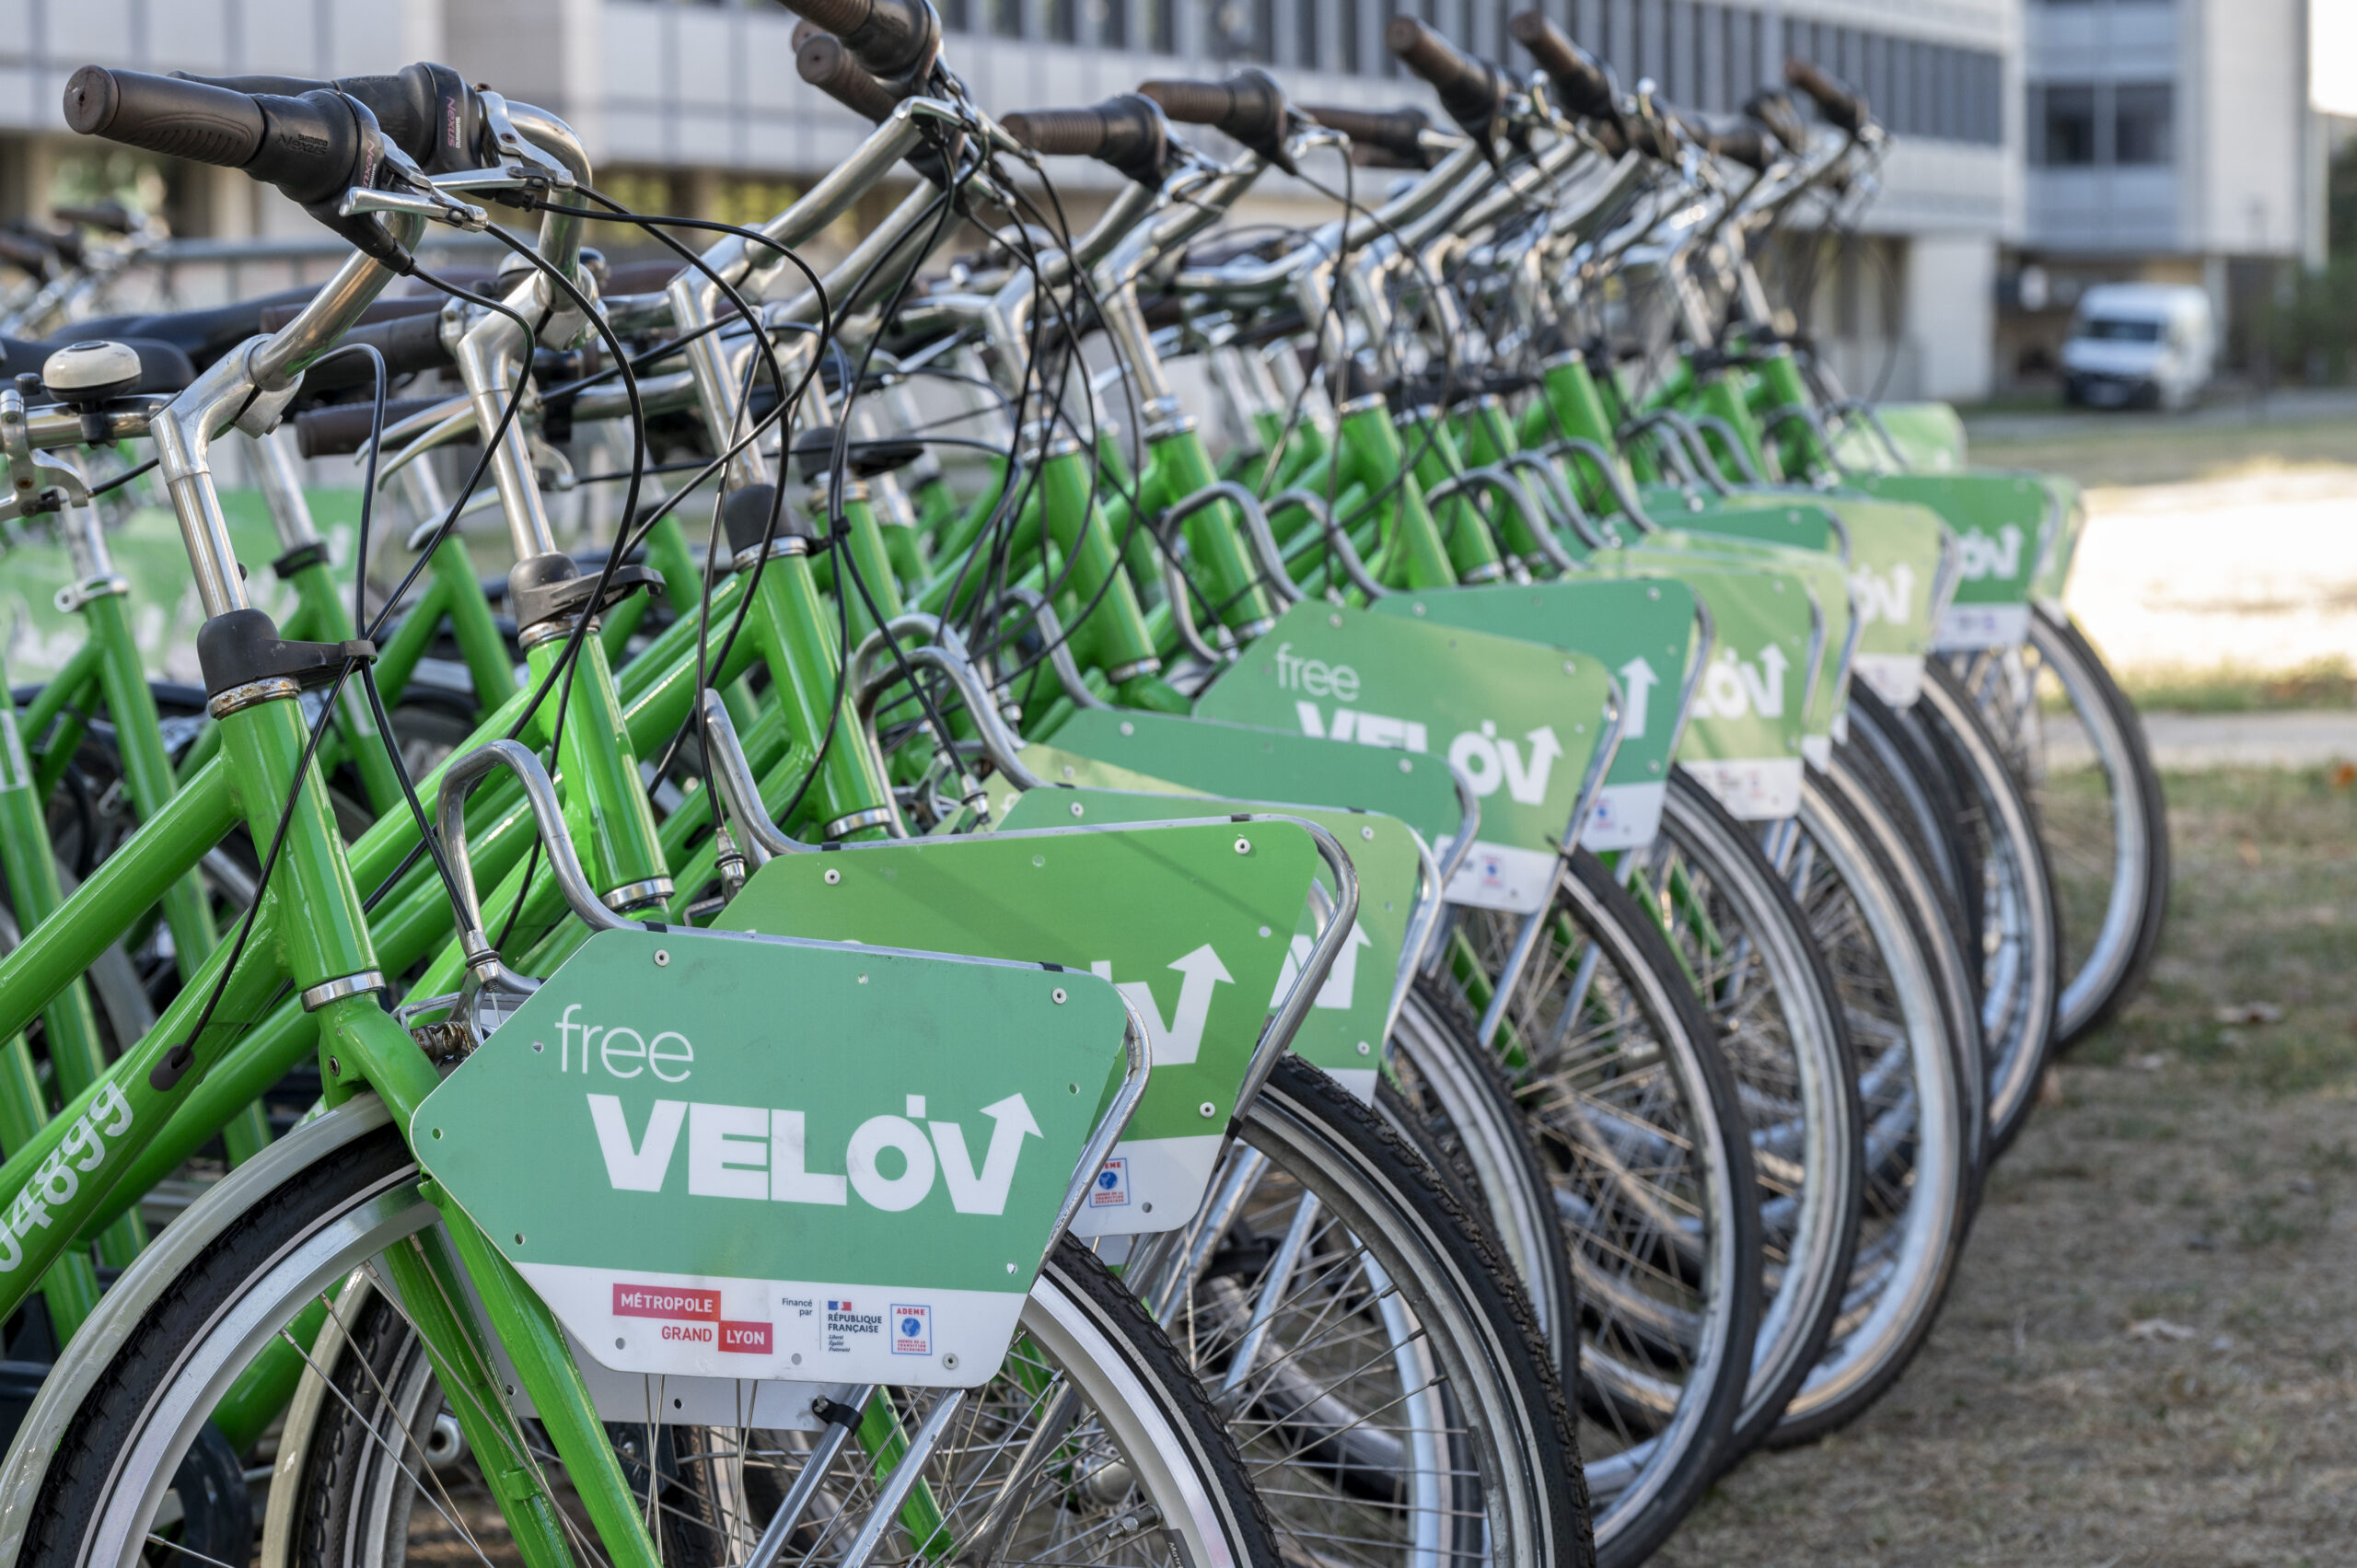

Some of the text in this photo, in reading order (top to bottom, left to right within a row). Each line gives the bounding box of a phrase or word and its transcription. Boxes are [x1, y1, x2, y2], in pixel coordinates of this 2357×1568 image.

[1275, 642, 1361, 703] free
[554, 1004, 694, 1084] free
[621, 1292, 714, 1313] MÉTROPOLE
[782, 1297, 813, 1307] Financé
[799, 1308, 813, 1318] par
[897, 1307, 925, 1316] ADEME
[828, 1313, 882, 1324] RÉPUBLIQUE
[828, 1323, 878, 1333] FRANÇAISE
[661, 1325, 765, 1345] GRAND LYON
